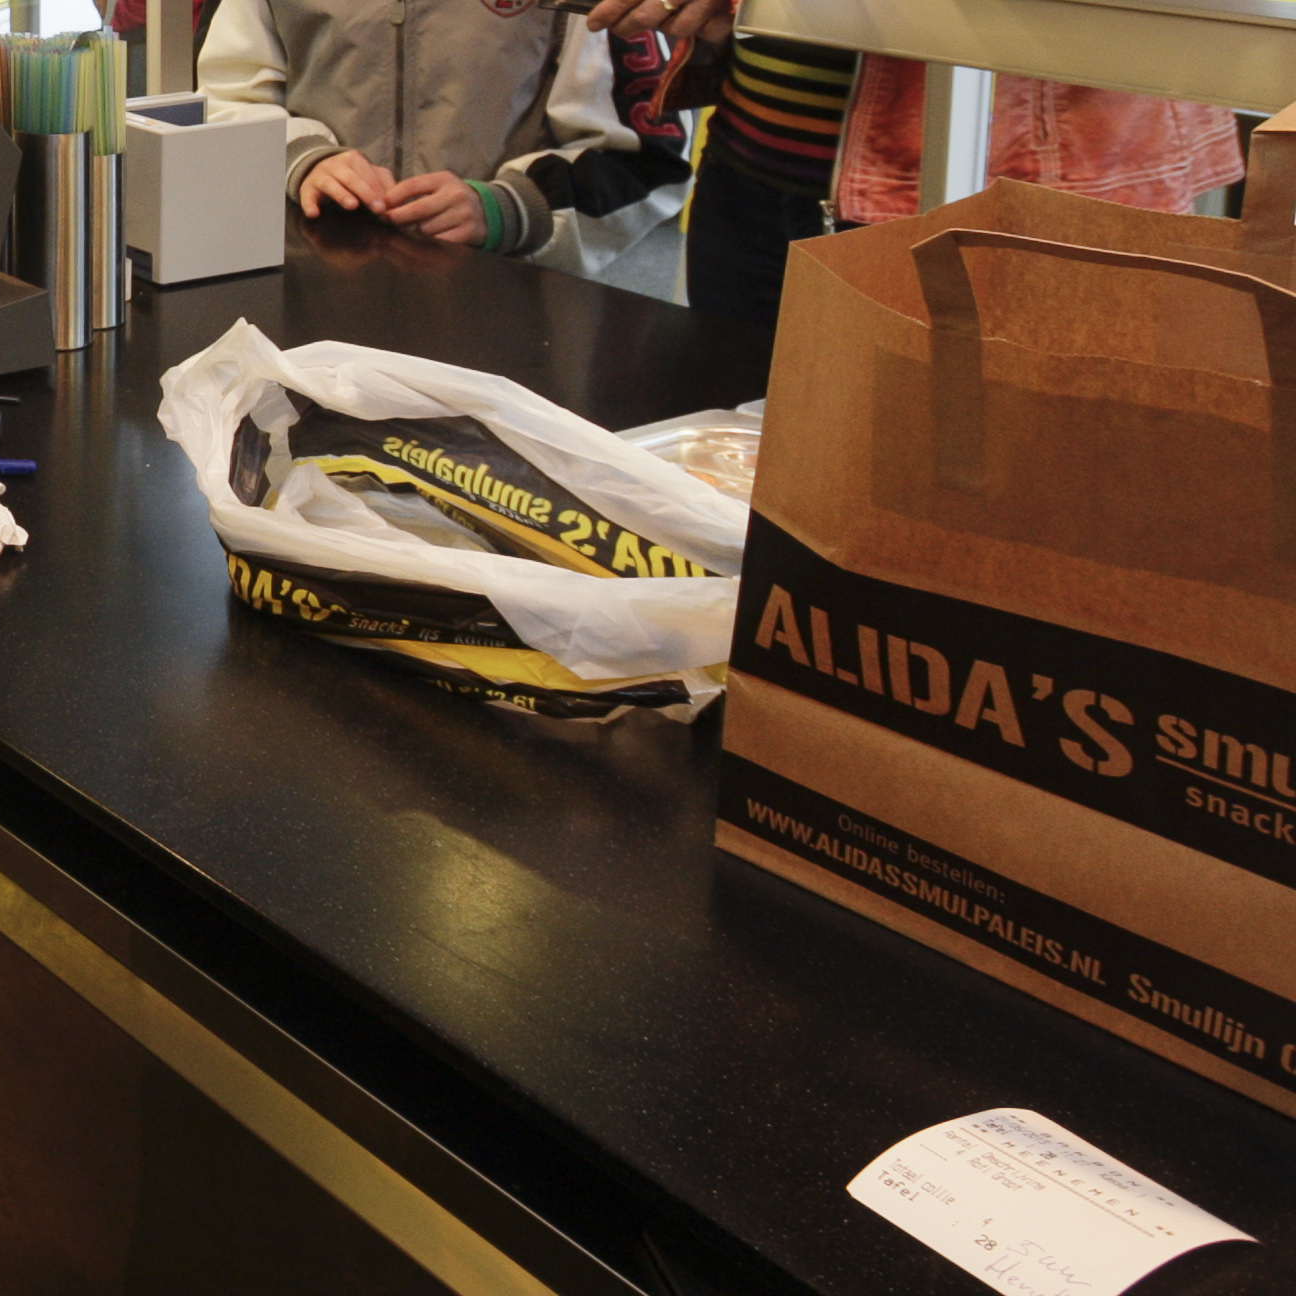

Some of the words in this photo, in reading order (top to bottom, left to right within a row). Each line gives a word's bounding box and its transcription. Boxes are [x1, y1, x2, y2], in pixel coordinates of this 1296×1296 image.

[348, 615, 408, 636] snacks
[754, 584, 1135, 778] ALIDA'S
[837, 813, 899, 856] Online
[907, 836, 1006, 904] bestellen:
[746, 797, 1106, 985] WWW.ALIDASSMULPALEIS.NL
[1127, 973, 1266, 1059] Smullijn
[876, 1169, 920, 1203] Tafel
[974, 1234, 998, 1251] 28
[889, 1158, 924, 1185] Totaal
[920, 1180, 956, 1205] collie
[982, 1217, 993, 1227] 4
